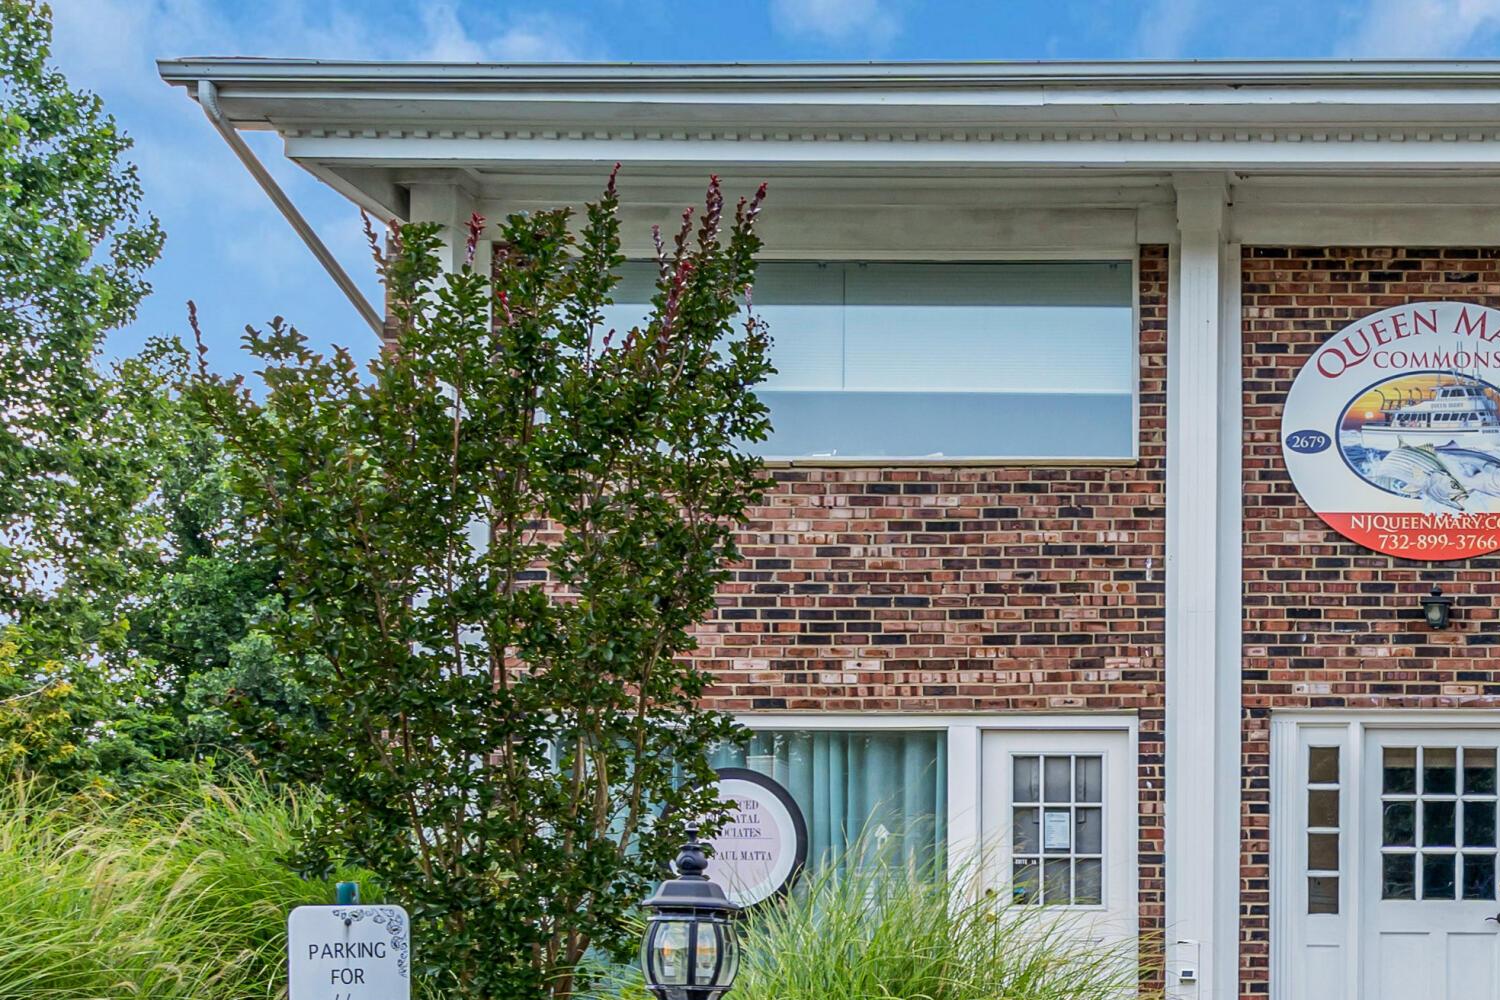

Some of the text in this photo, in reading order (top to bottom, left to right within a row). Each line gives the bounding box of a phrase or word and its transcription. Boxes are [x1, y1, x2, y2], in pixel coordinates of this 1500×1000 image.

[1316, 308, 1439, 379] QUEEN
[1291, 435, 1326, 449] 2679
[1378, 534, 1498, 550] 732-899-3766
[740, 850, 773, 861] MATTA
[308, 942, 387, 960] PARKING
[331, 968, 365, 984] FOR
